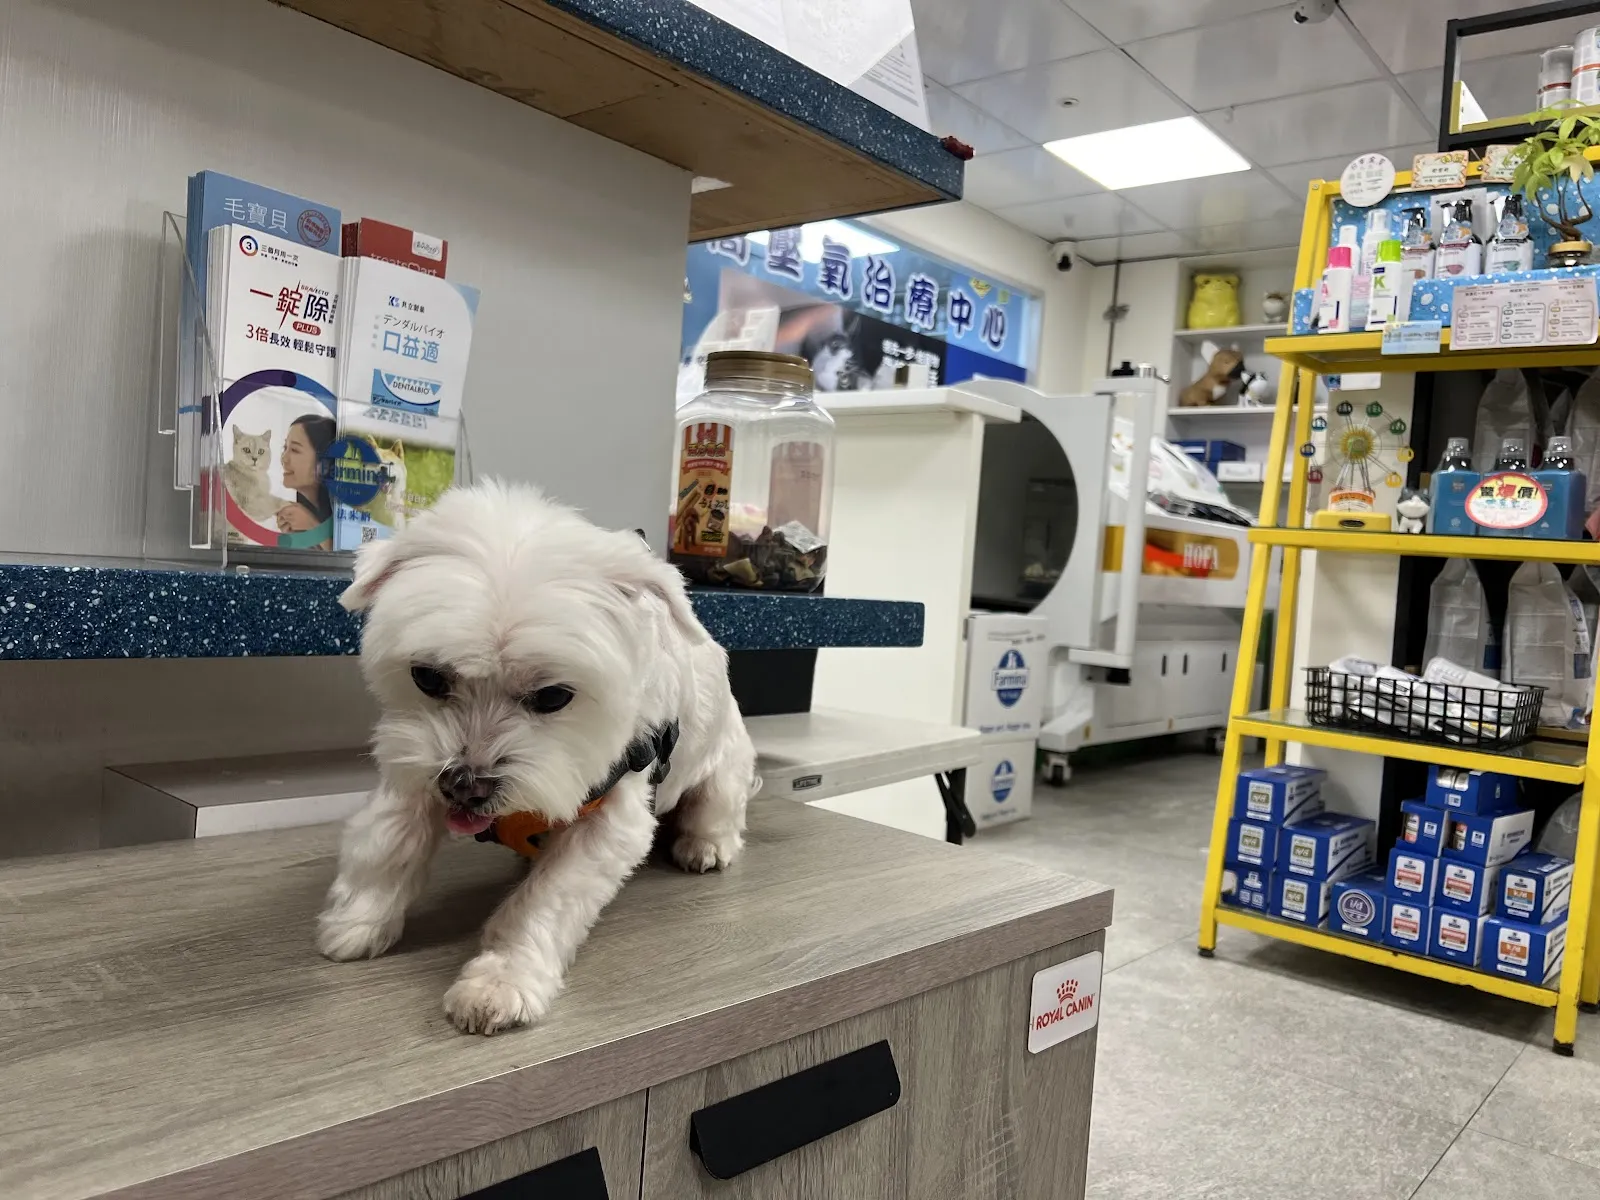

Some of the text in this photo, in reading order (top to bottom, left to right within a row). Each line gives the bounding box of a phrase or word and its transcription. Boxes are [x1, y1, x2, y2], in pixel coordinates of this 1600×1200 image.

[223, 197, 289, 234] 毛寶貝
[246, 241, 253, 251] 3
[296, 323, 318, 335] PLUS
[383, 330, 440, 363] 口益適
[392, 381, 430, 395] DENTALBIO
[1036, 995, 1094, 1030] ROYAL CANIN
